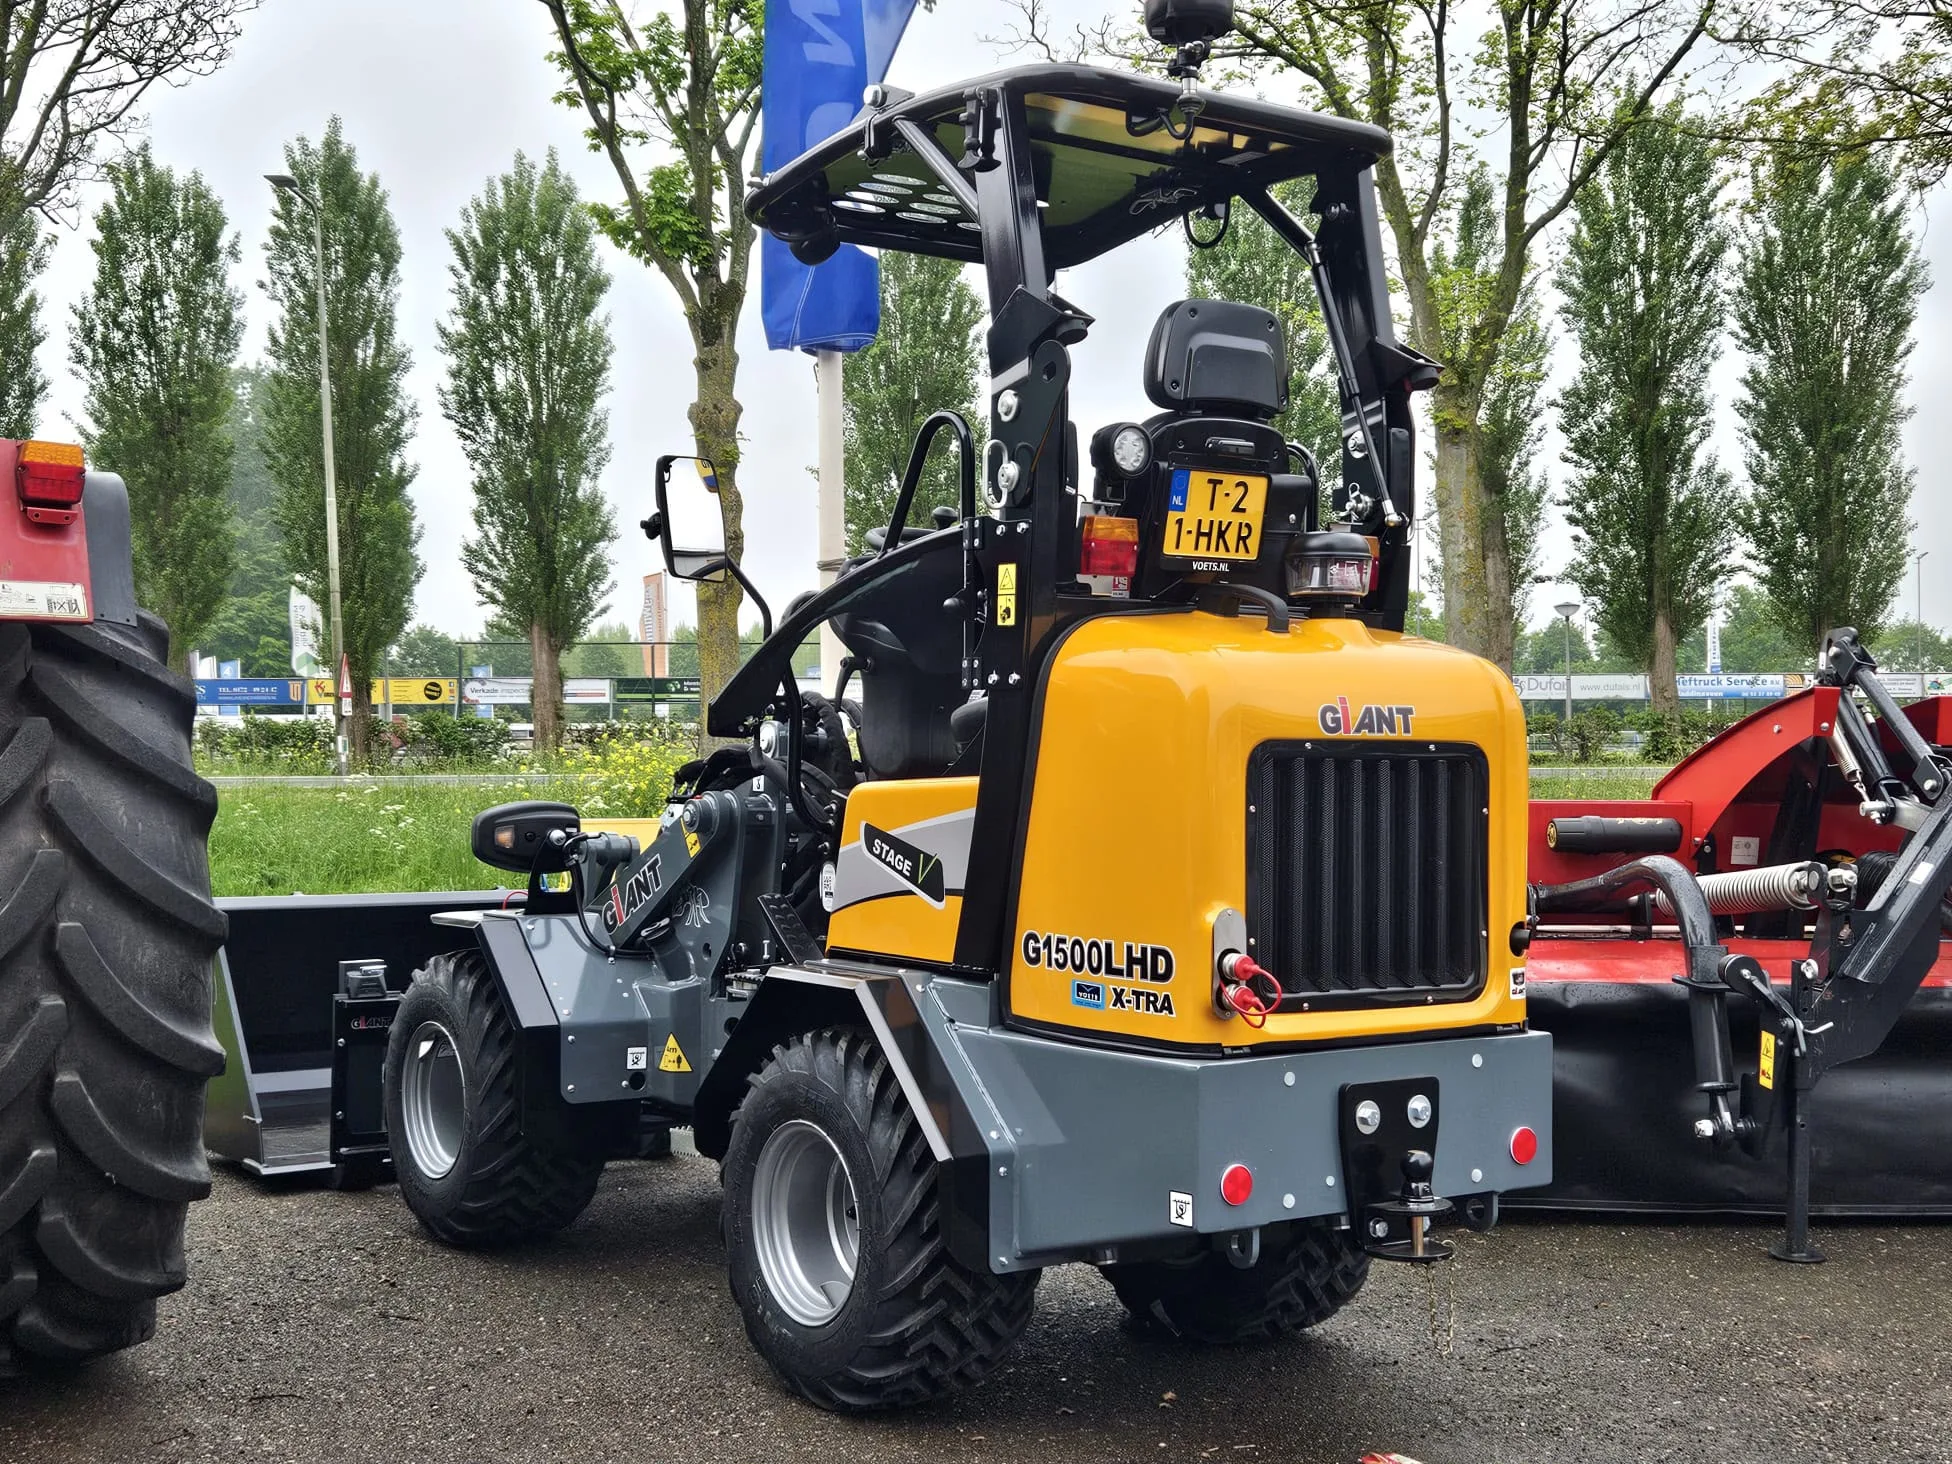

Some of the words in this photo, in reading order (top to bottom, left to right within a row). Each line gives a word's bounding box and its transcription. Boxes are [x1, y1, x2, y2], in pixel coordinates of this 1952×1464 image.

[1171, 495, 1184, 506] NL
[1207, 478, 1249, 513] T-2
[1175, 517, 1250, 554] 1-HKR
[1192, 561, 1230, 572] VOETS.NL
[1527, 677, 1567, 691] Dufai
[872, 838, 912, 877] STAGE
[1022, 930, 1175, 984] G1500LHD
[1110, 985, 1176, 1017] X-TRA
